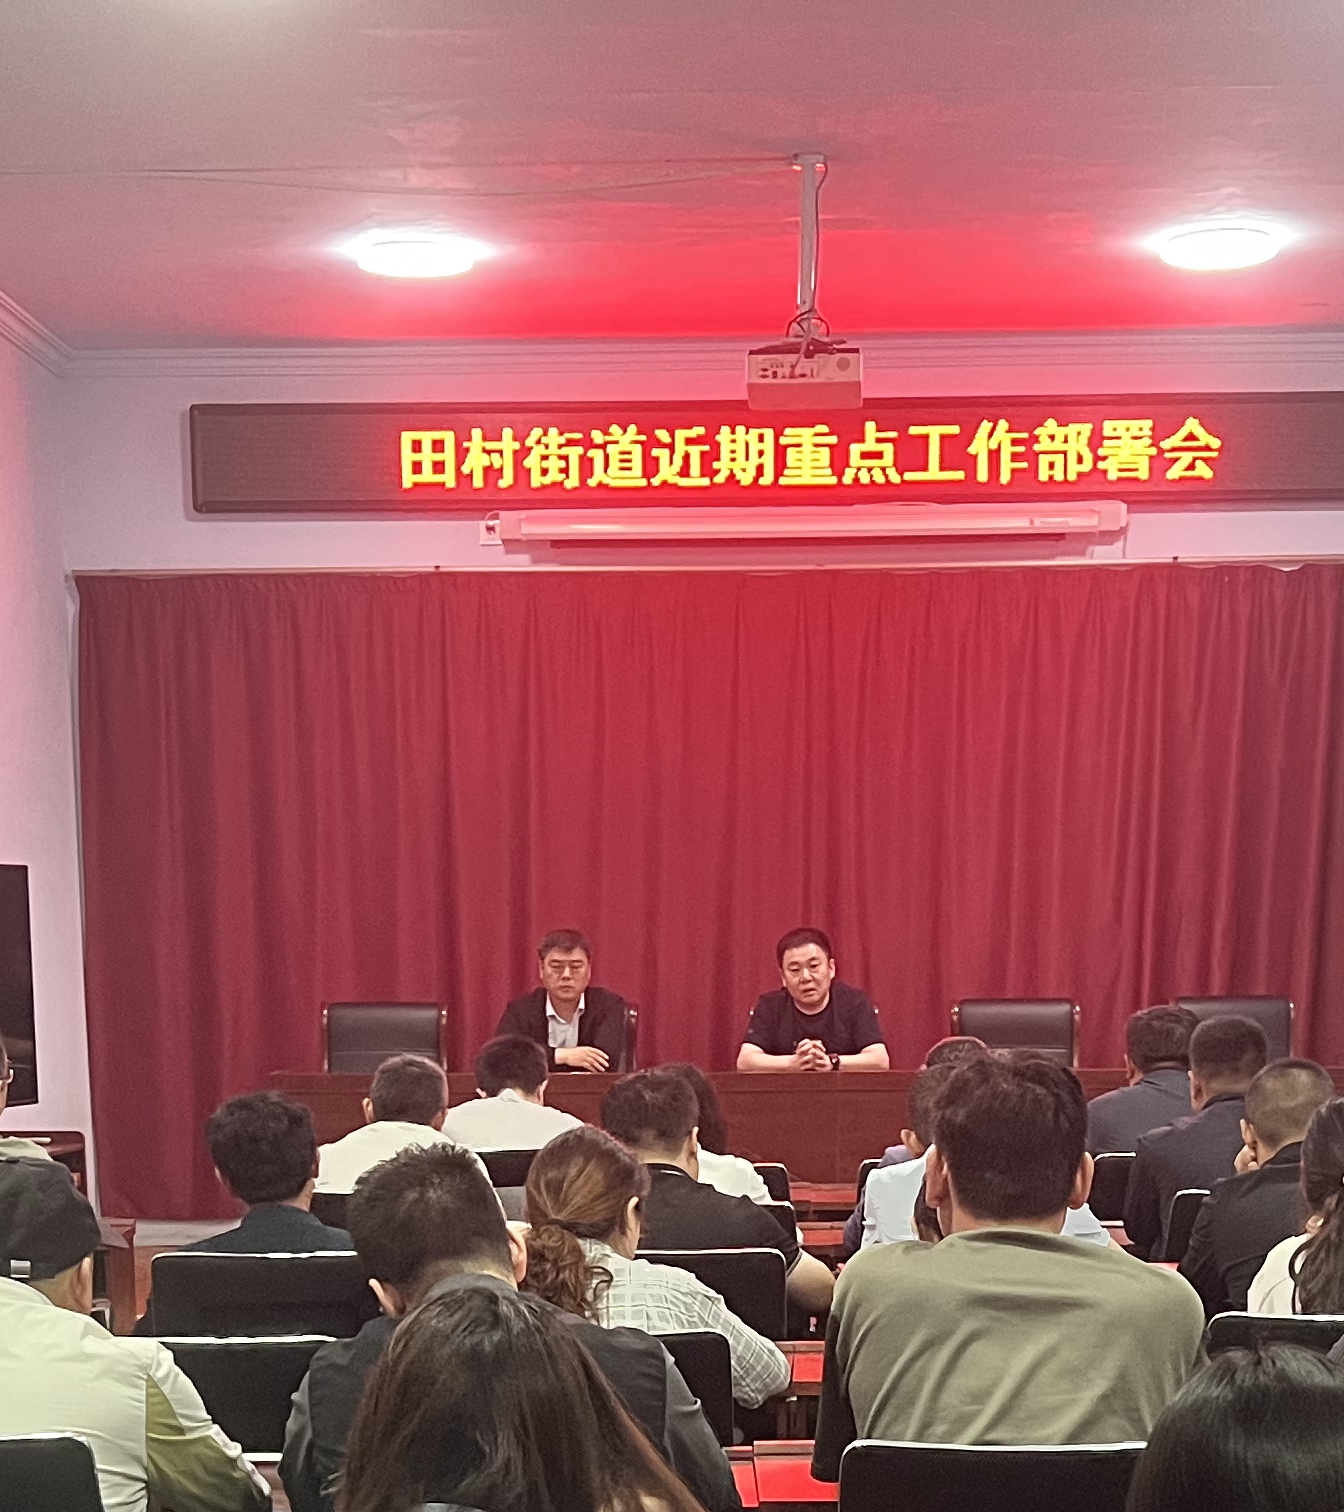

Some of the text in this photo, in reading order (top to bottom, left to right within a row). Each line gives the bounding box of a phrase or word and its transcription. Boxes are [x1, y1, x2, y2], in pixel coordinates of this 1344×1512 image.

[399, 416, 1223, 489] 田村街道近期重点工作部署会
